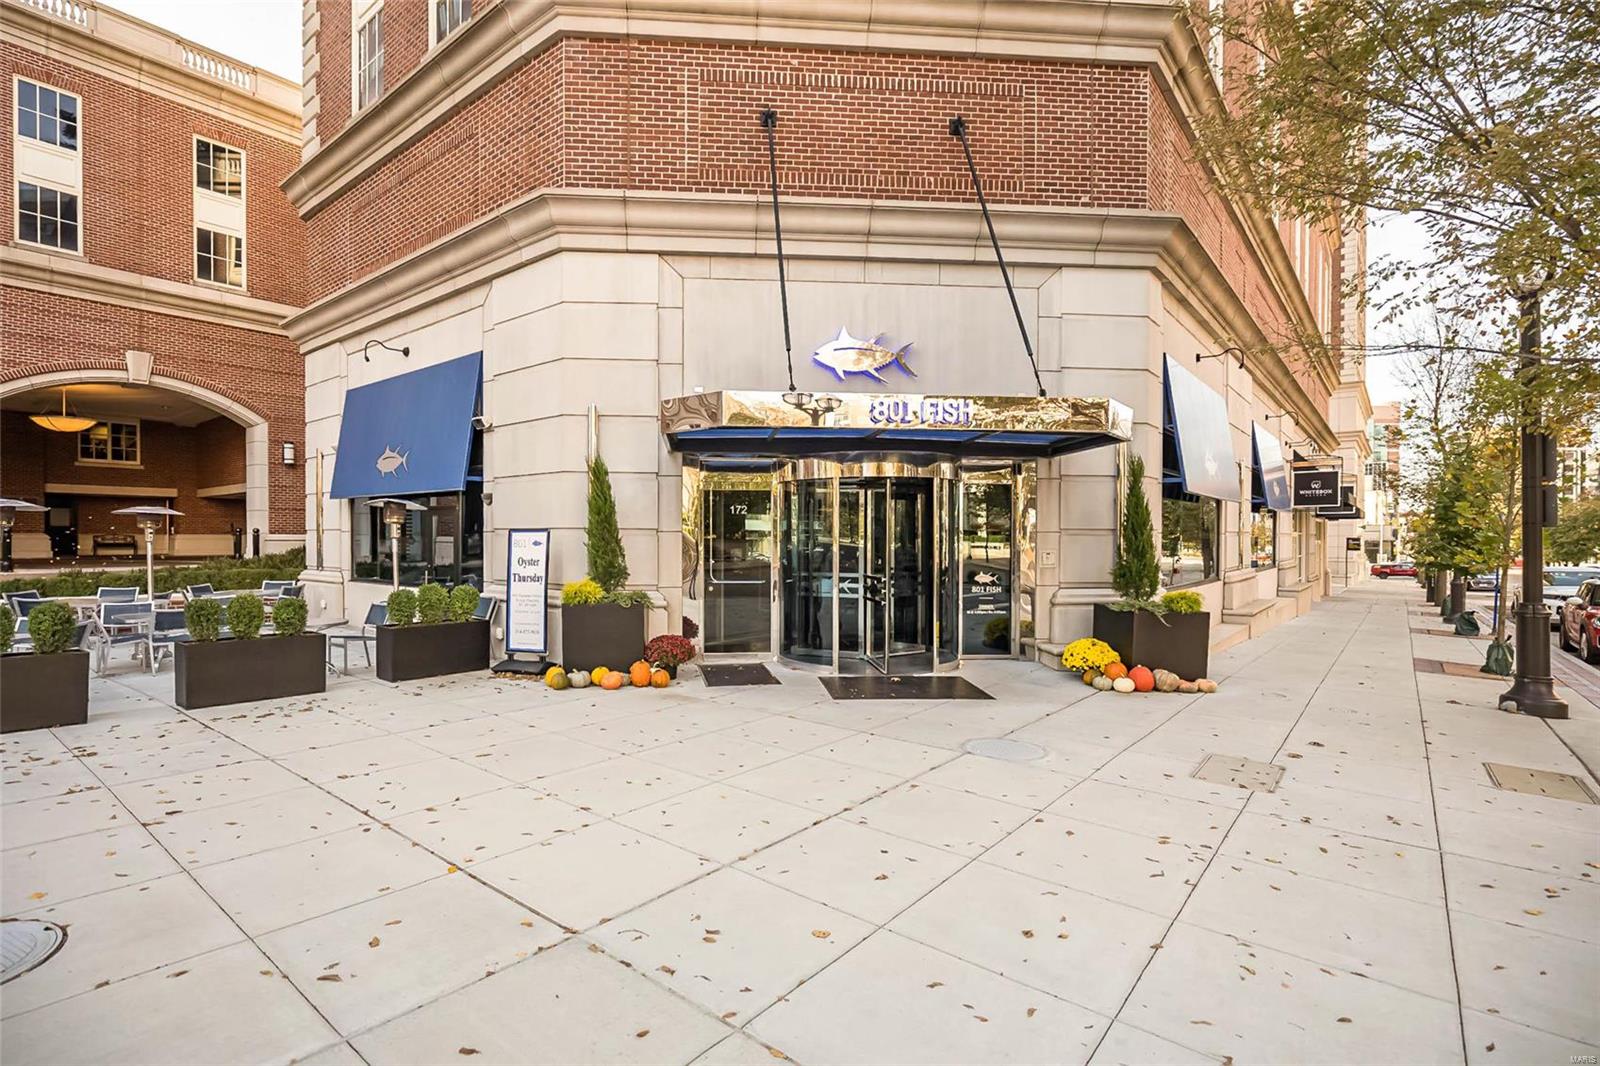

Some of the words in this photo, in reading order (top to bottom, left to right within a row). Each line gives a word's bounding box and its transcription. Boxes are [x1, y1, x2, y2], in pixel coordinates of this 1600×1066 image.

[869, 399, 914, 424] 801
[921, 398, 974, 426] FISH
[730, 505, 748, 514] 172
[517, 556, 540, 569] Oyster
[512, 572, 544, 585] Thursday
[971, 585, 985, 593] 801
[986, 585, 1002, 593] FISH
